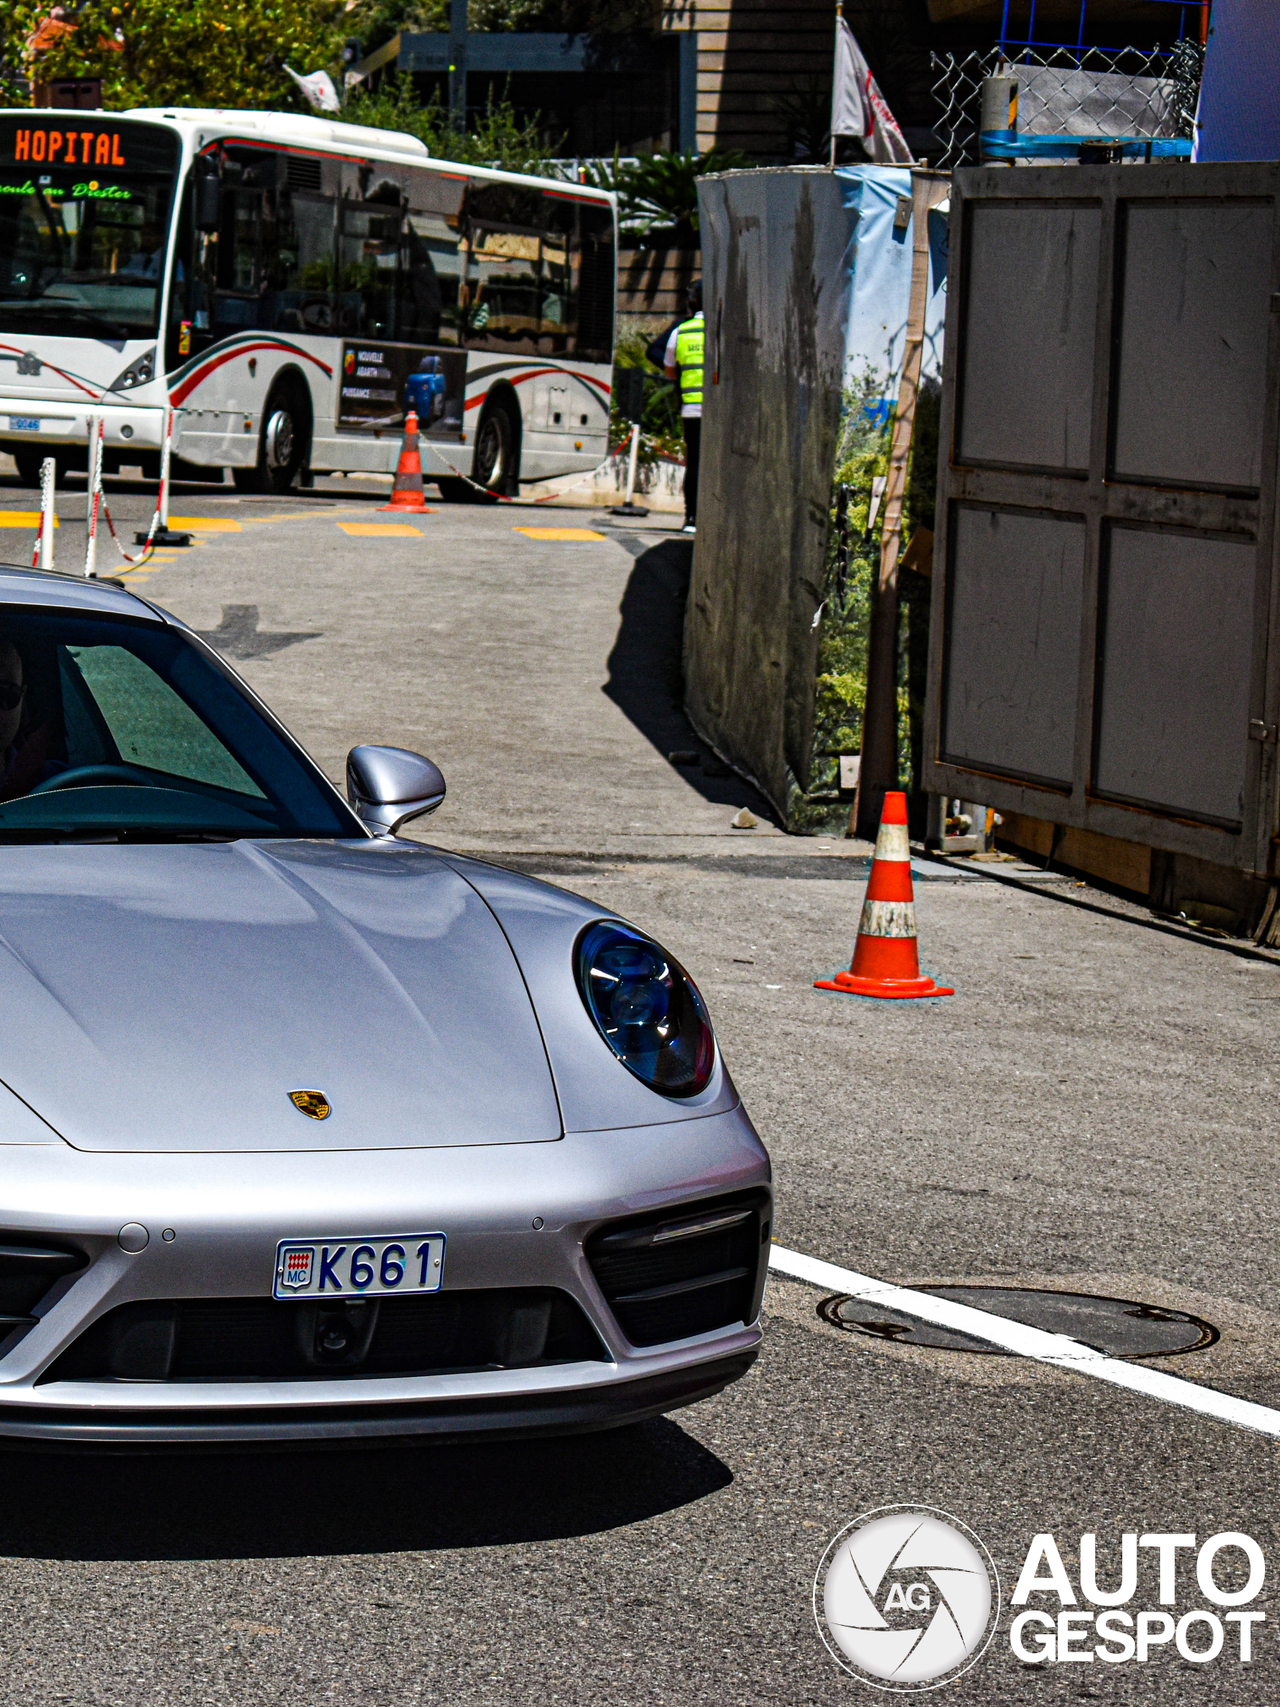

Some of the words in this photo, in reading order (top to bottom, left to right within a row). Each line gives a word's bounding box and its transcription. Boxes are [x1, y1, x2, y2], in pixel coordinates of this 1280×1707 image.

[14, 129, 125, 166] HOPITAL
[42, 186, 65, 196] au
[287, 1269, 307, 1283] MC
[318, 1241, 430, 1289] K661
